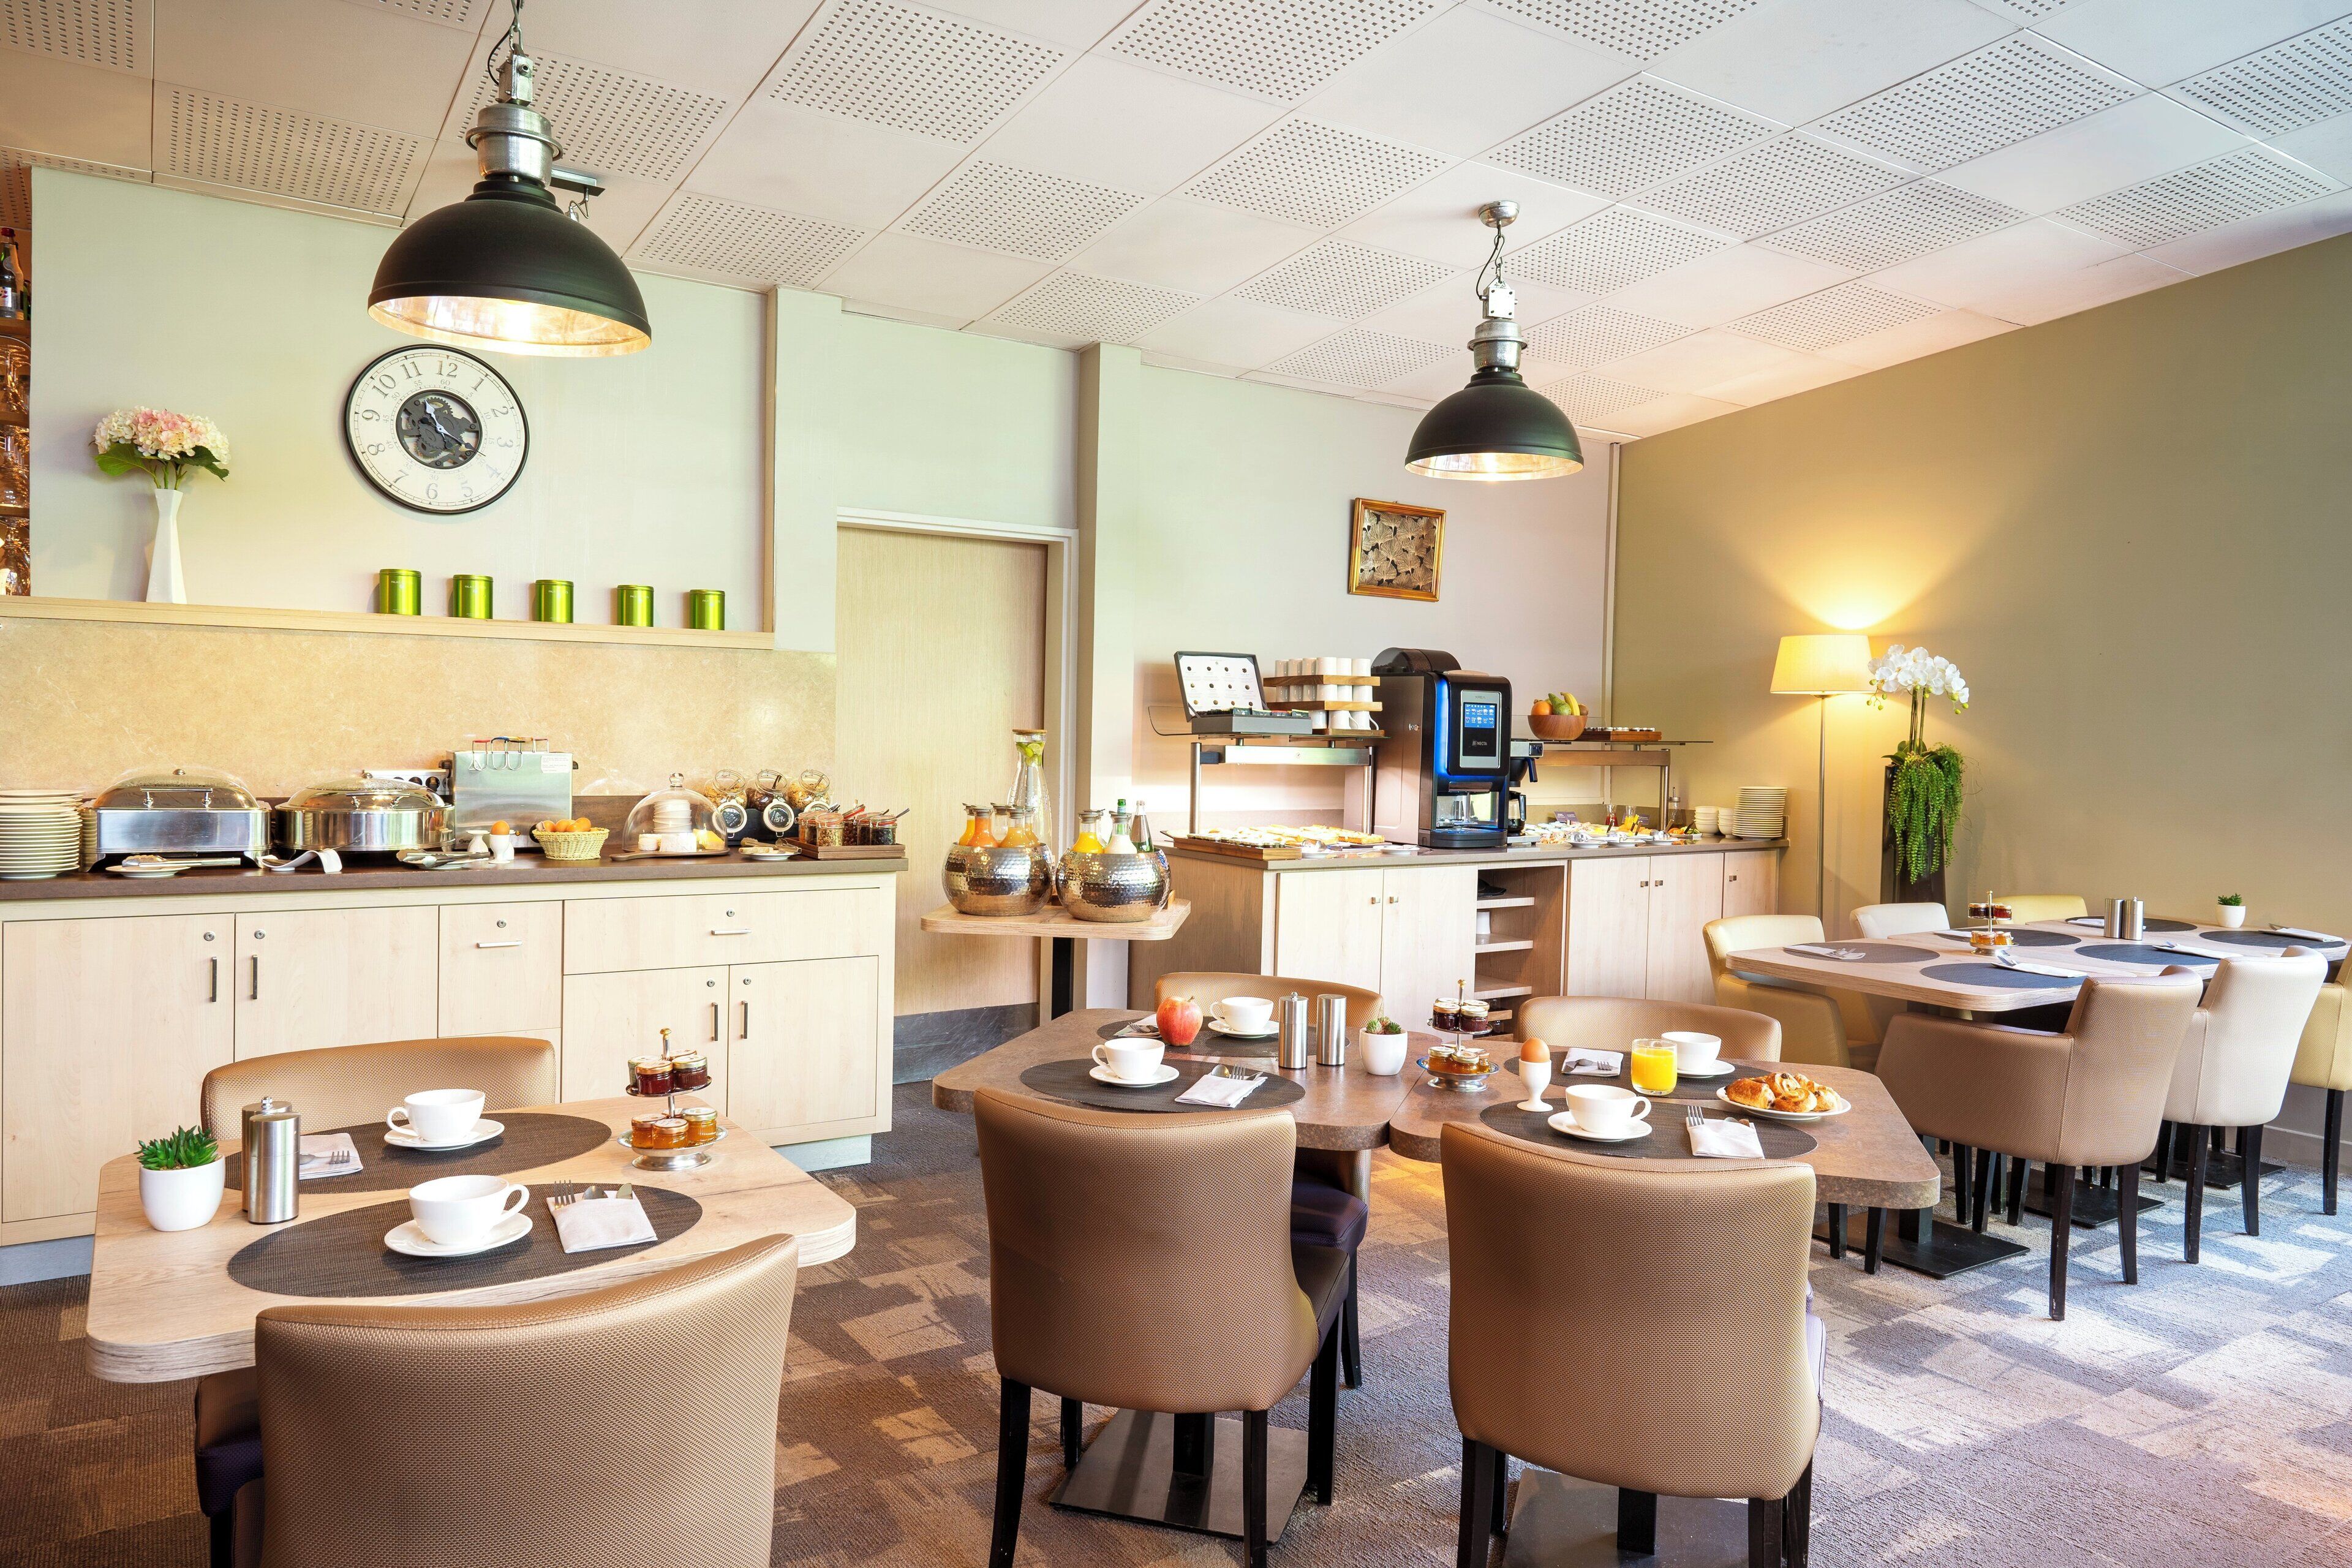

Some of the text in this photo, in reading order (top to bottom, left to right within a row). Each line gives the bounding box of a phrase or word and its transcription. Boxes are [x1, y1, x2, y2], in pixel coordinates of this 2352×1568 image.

[400, 361, 423, 380] 11
[435, 360, 458, 378] 12
[372, 374, 396, 399] 10
[471, 377, 484, 392] 1
[391, 391, 400, 401] 50
[362, 409, 380, 422] 9
[383, 414, 390, 424] 45
[491, 406, 509, 418] 2
[368, 443, 385, 456] 8
[497, 437, 513, 448] 3
[393, 470, 409, 484] 7
[486, 464, 502, 478] 4
[426, 483, 438, 500] 6
[461, 480, 473, 497] 5
